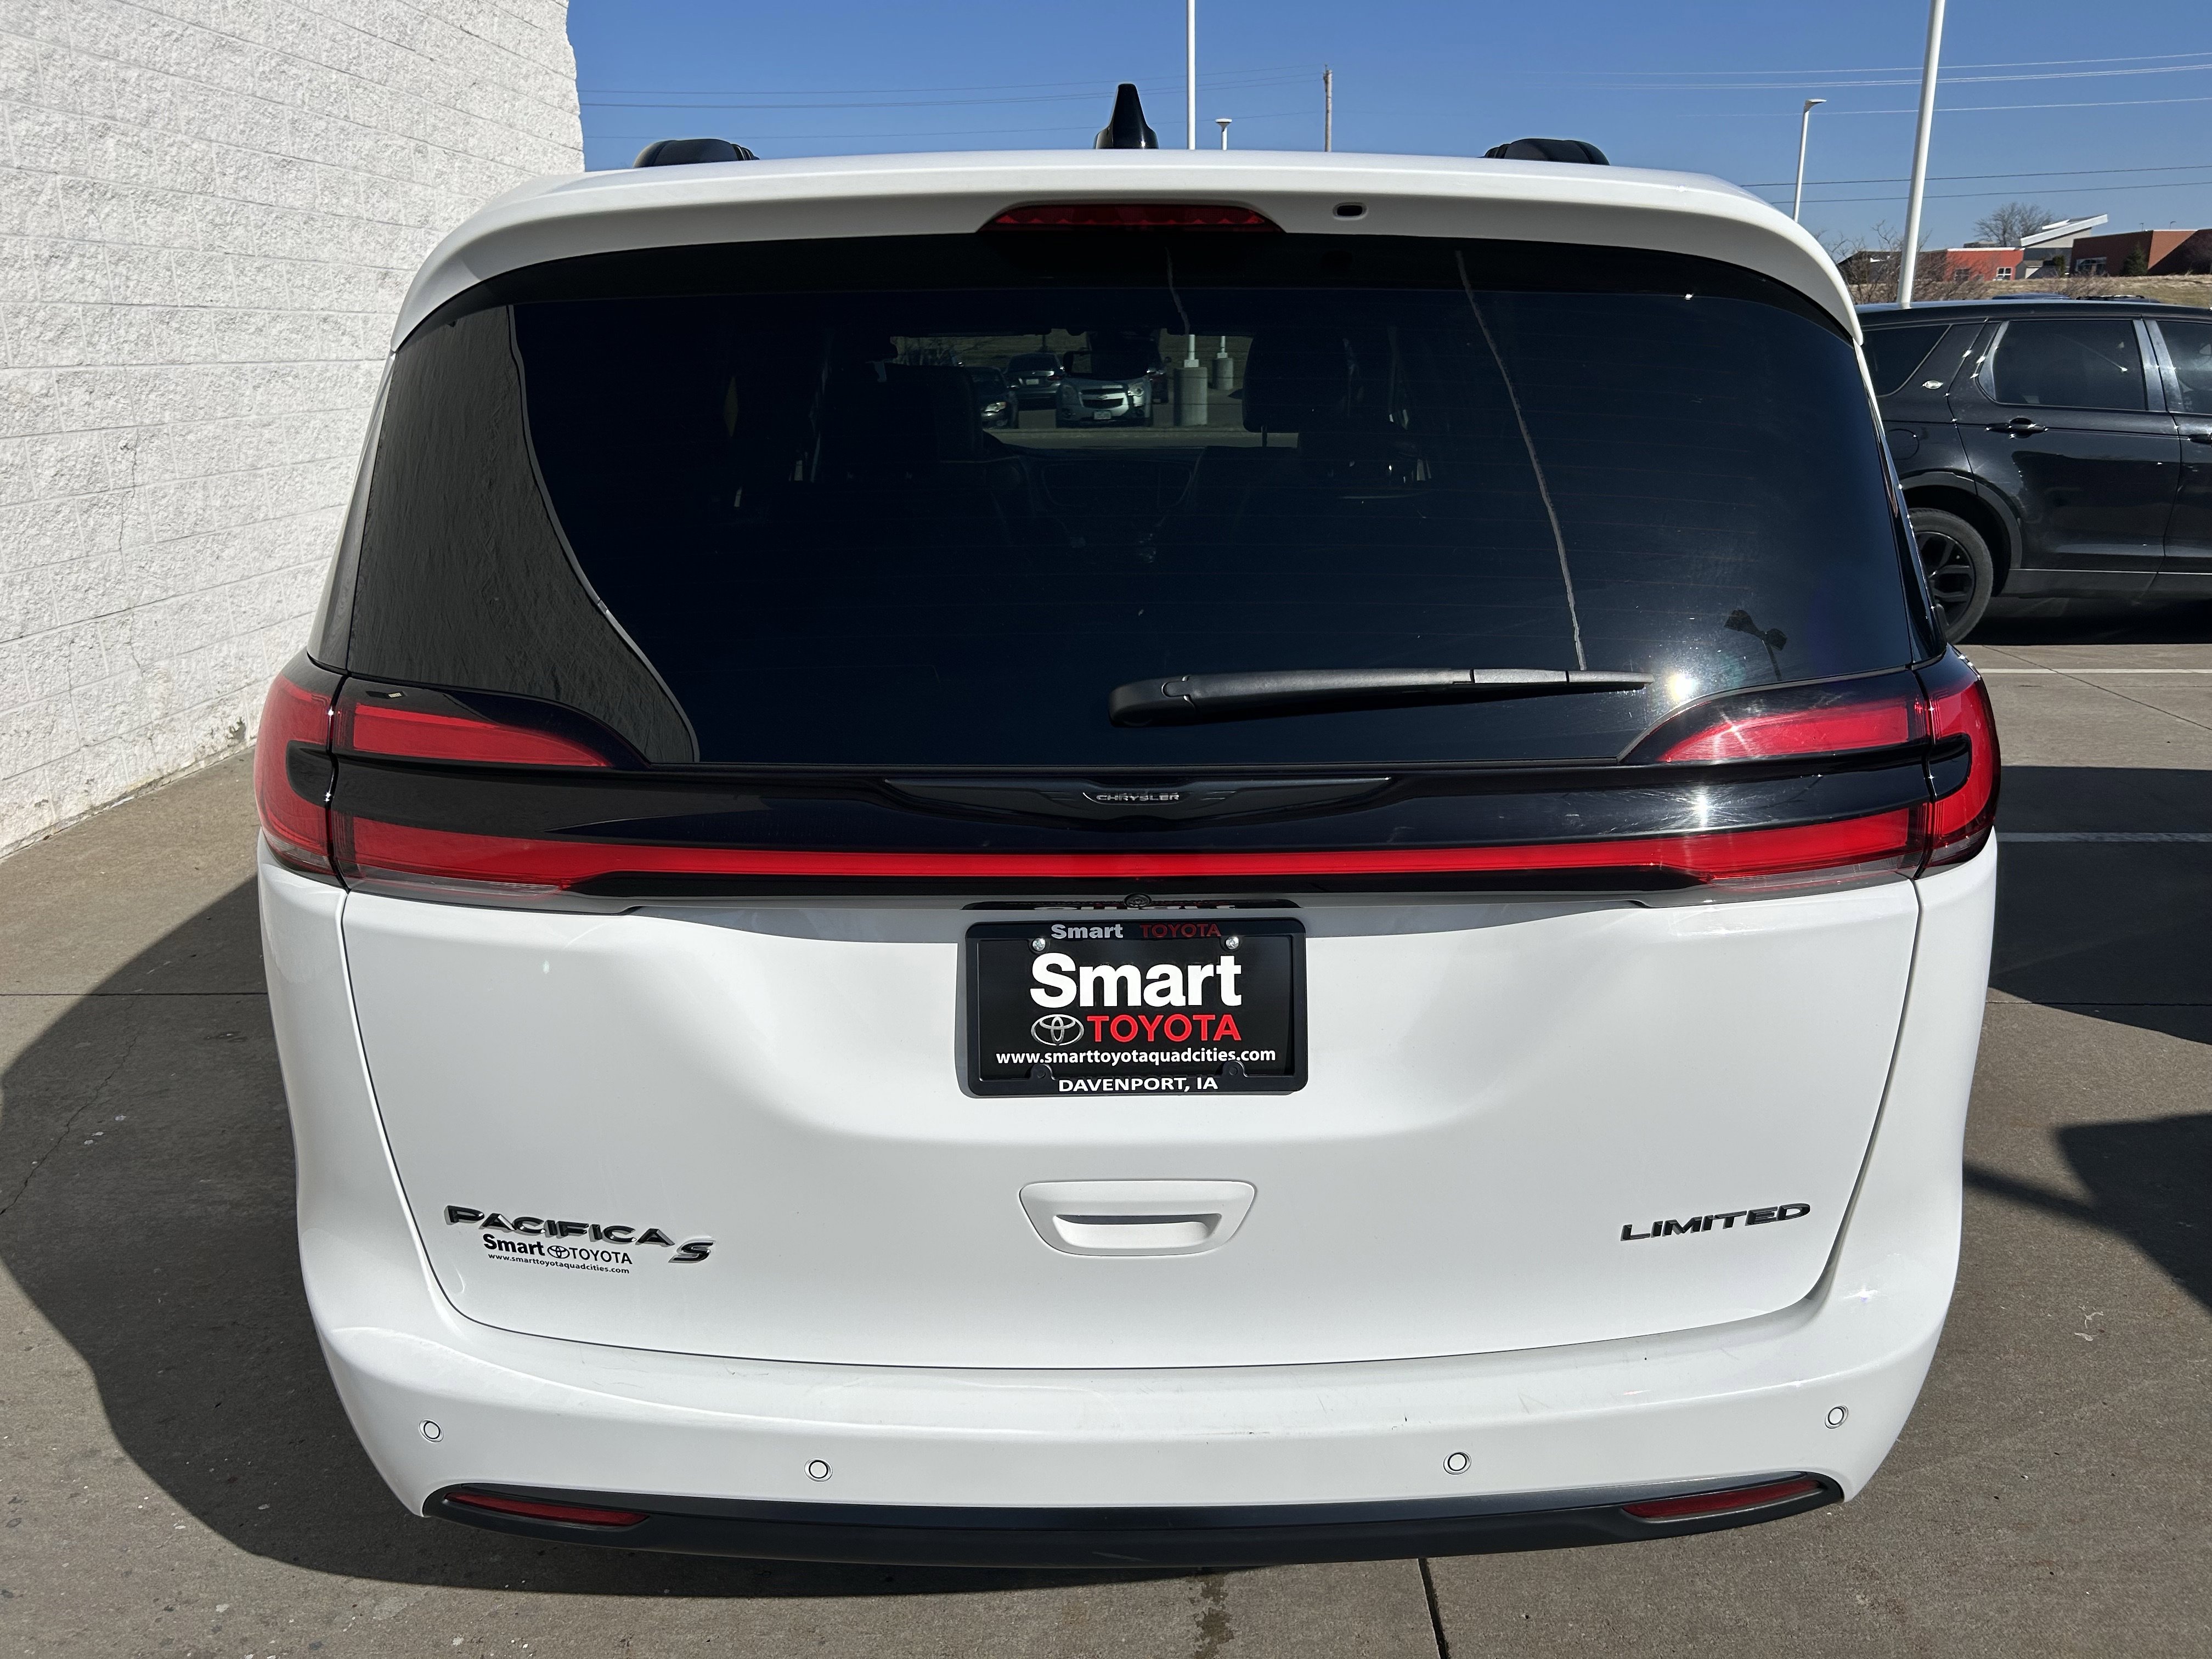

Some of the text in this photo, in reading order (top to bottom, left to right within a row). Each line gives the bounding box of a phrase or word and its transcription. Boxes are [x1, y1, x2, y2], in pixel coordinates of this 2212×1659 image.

[1096, 792, 1180, 801] CHRYSLER
[1051, 923, 1222, 939] Smart TOYOTA
[1030, 952, 1242, 1008] Smart
[1087, 1014, 1242, 1042] TOYOTA
[996, 1048, 1276, 1066] www.smarttoyotaquadcities.com
[1059, 1077, 1218, 1092] DAVENPORT, IA
[444, 1205, 716, 1263] PACIFICA S
[1620, 1203, 1811, 1242] LIMITED
[482, 1233, 633, 1265] Smart TOYOTA
[488, 1253, 630, 1274] www.smarttoyotaquadcities.com
